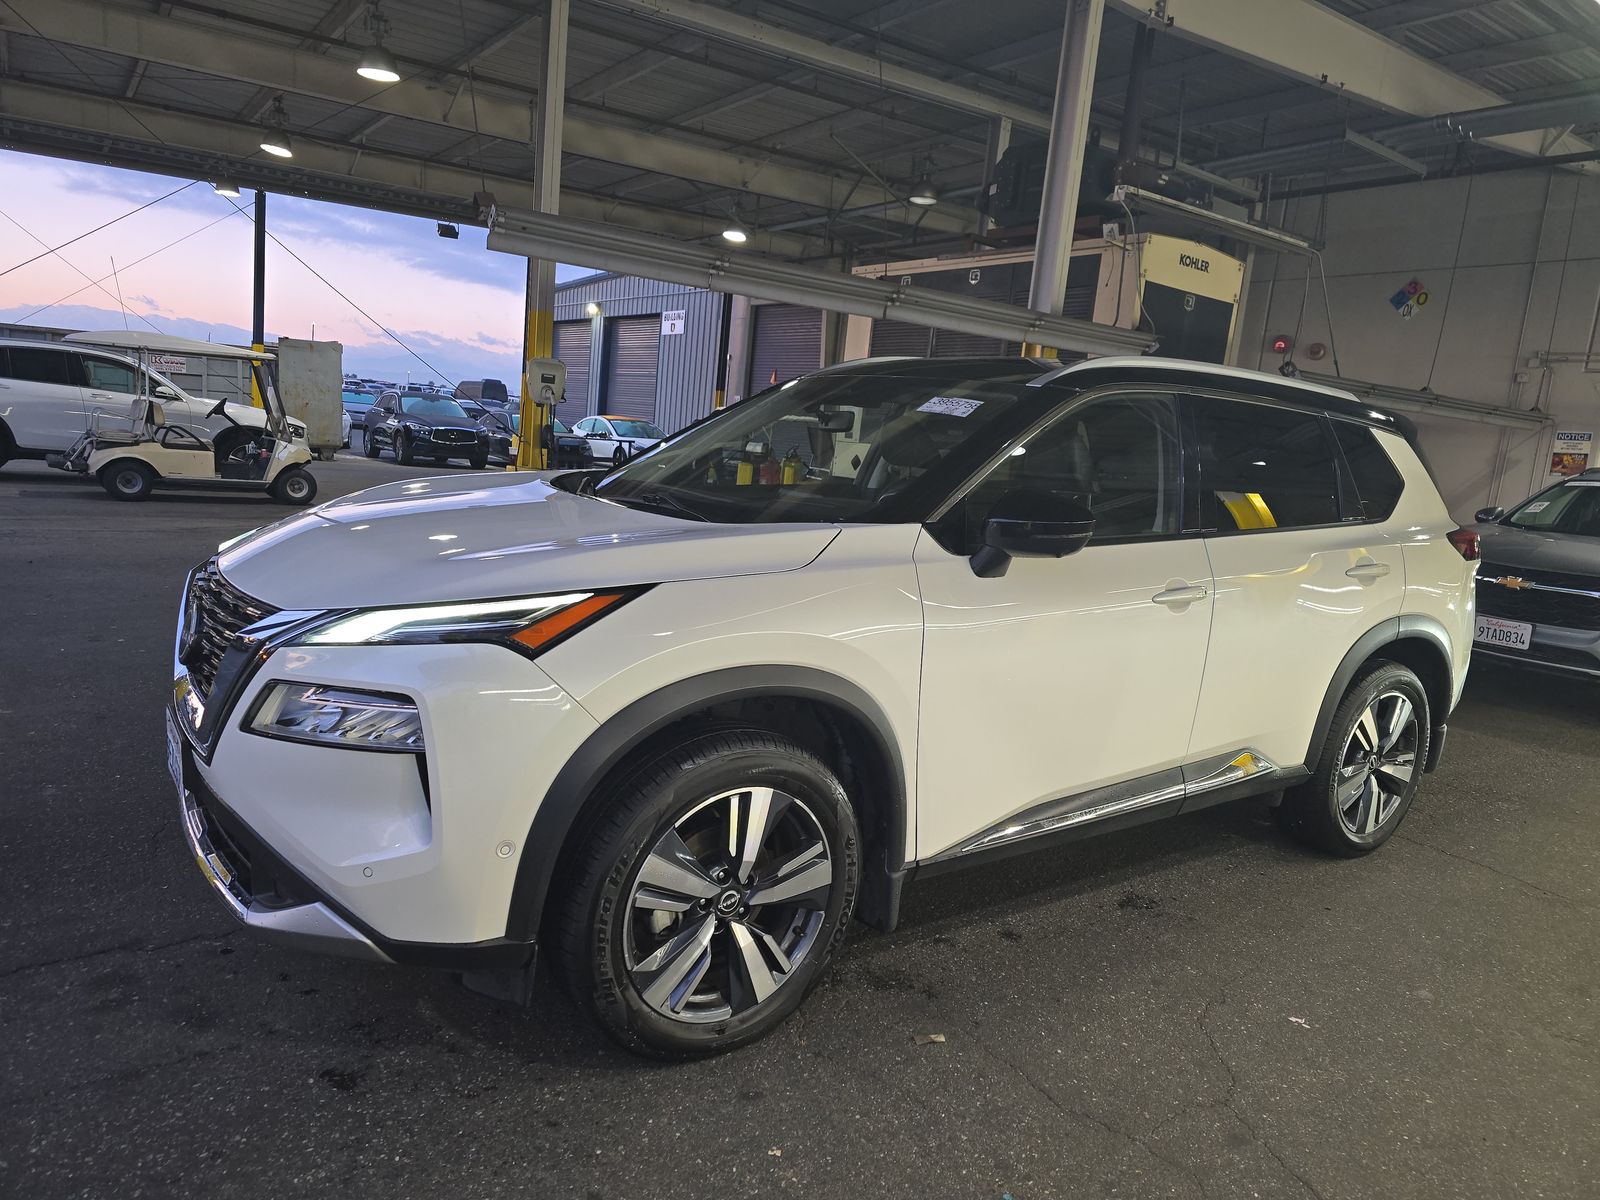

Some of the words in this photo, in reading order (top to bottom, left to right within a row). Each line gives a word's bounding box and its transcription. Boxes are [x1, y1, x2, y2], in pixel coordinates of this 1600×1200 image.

[1179, 253, 1210, 273] KOHLER
[663, 312, 685, 322] BUILDING
[1558, 433, 1590, 441] NOTICE
[1477, 625, 1525, 646] 9TAD834
